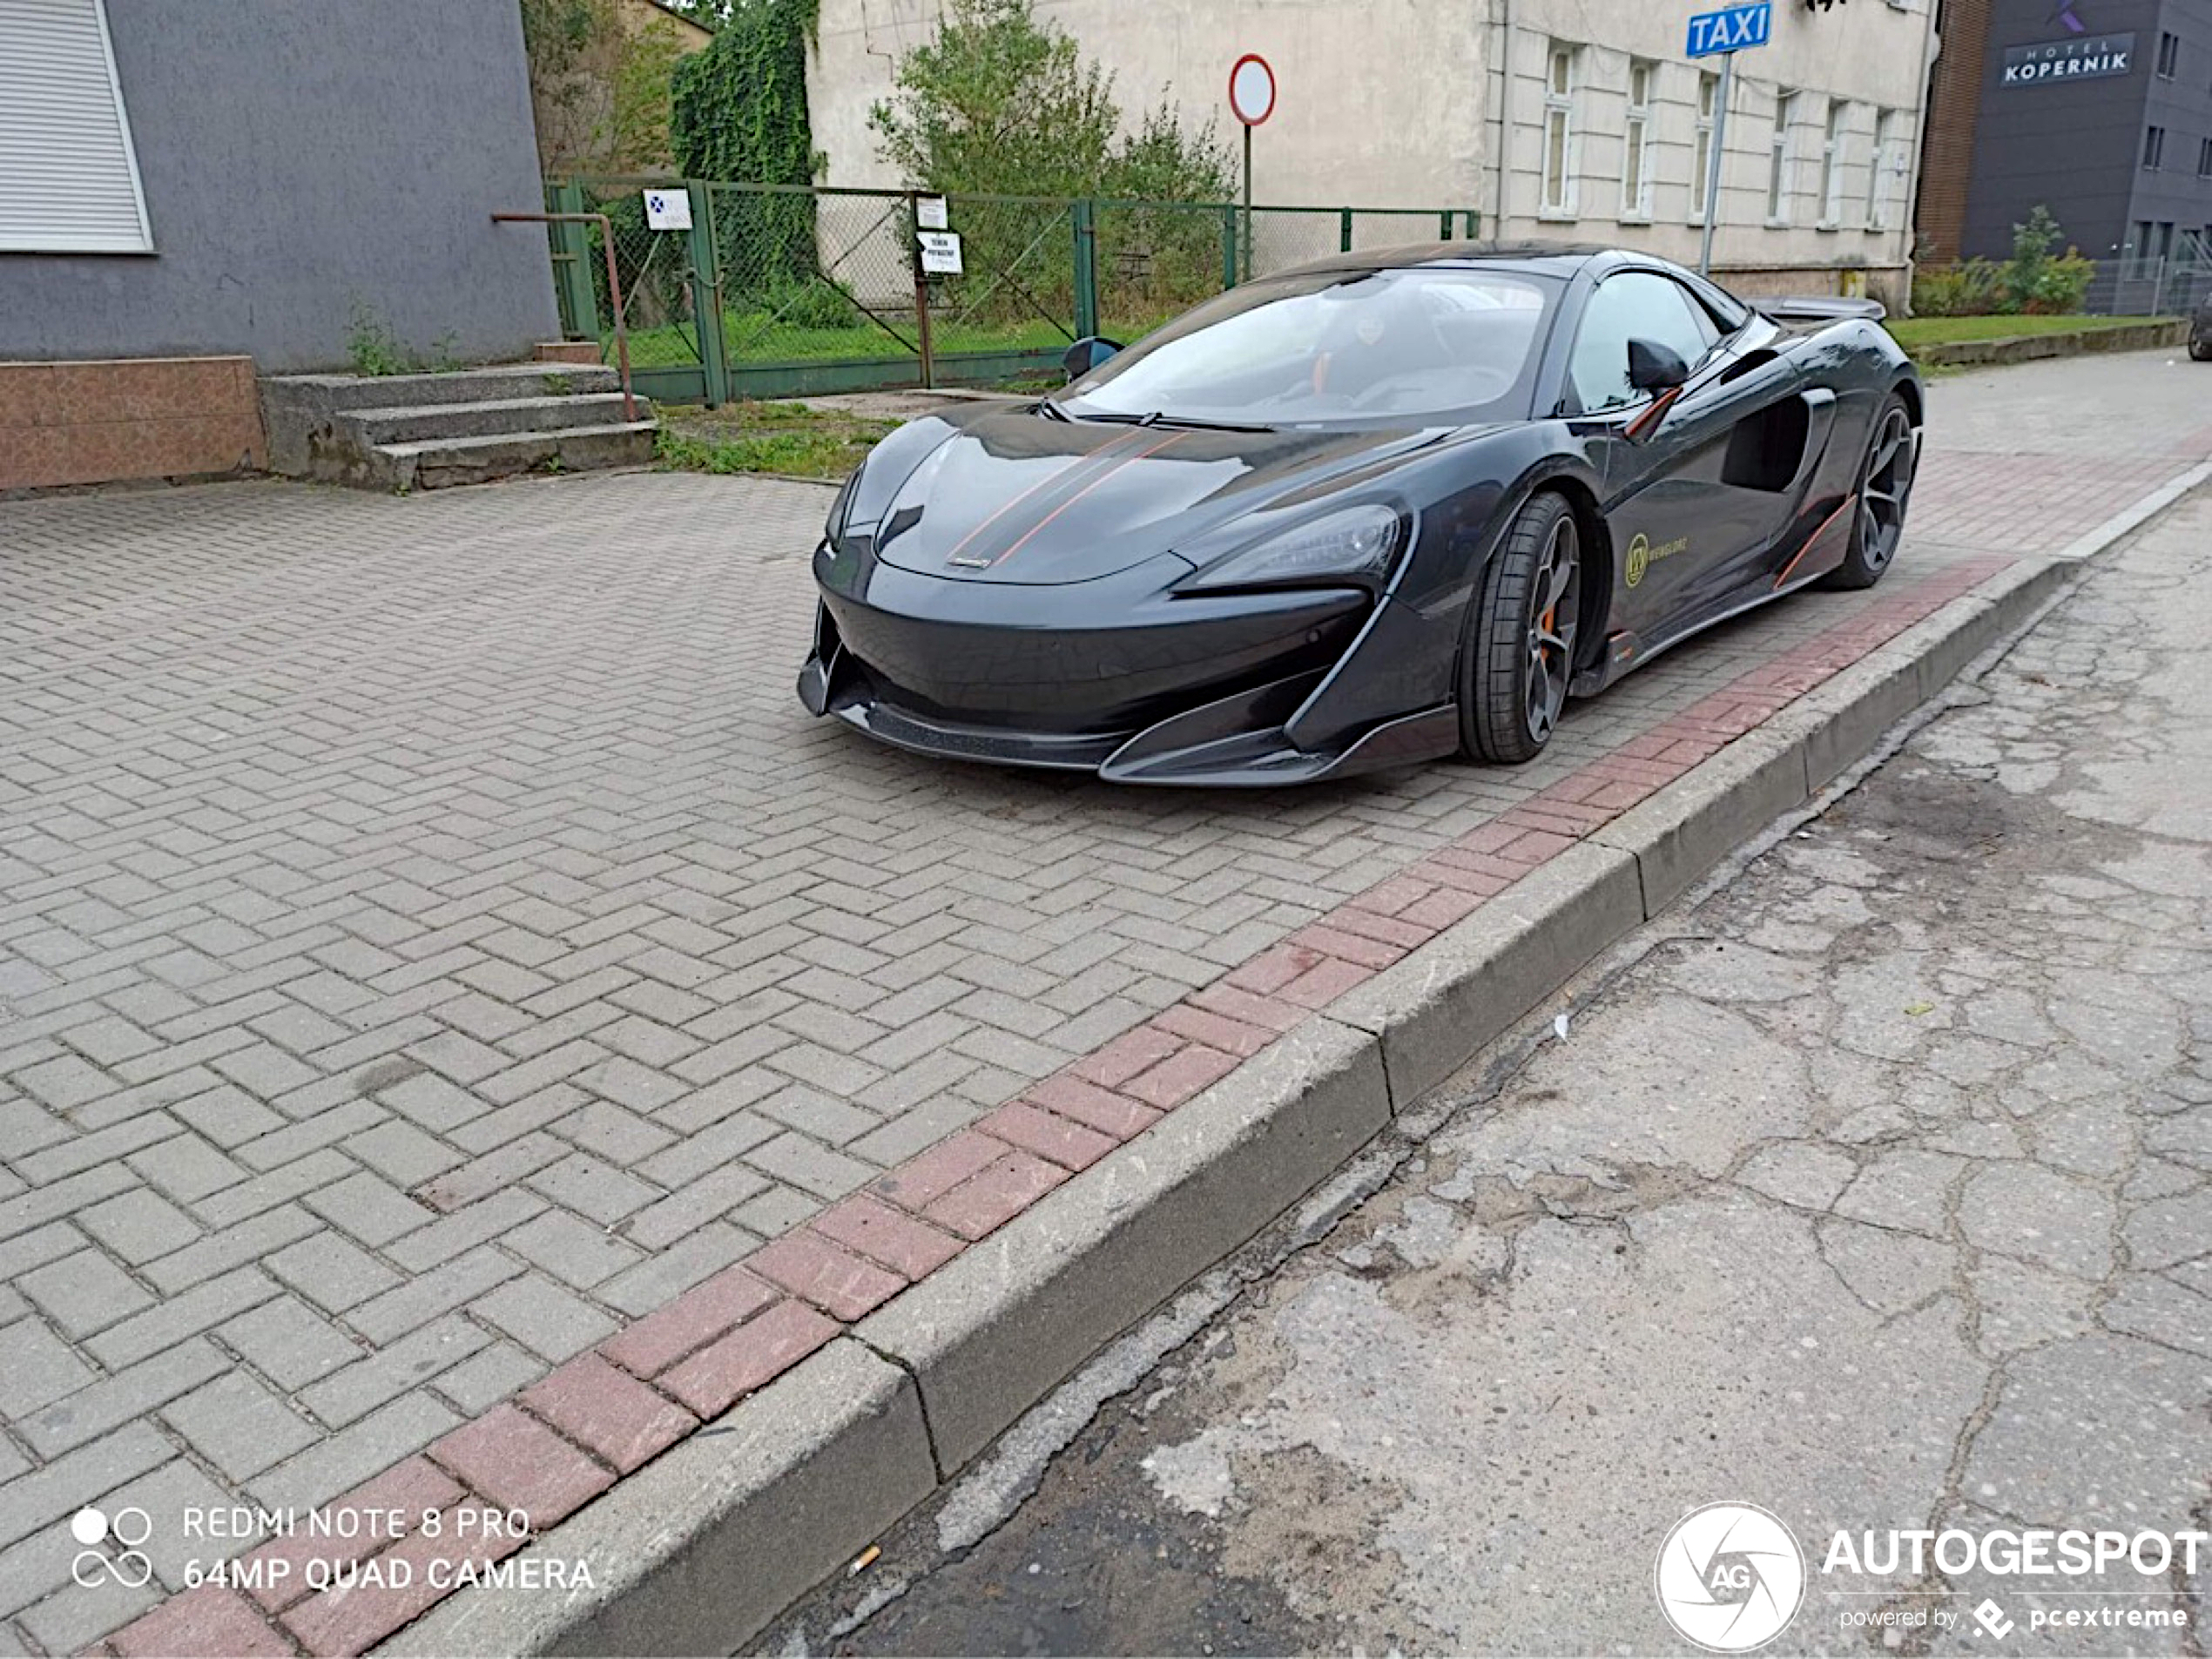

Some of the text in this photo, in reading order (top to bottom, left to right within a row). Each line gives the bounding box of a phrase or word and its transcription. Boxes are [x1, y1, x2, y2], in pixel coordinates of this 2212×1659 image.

[1693, 7, 1767, 51] TAXI
[2027, 40, 2109, 60] HOTEL
[2005, 52, 2127, 81] KOPERNIK
